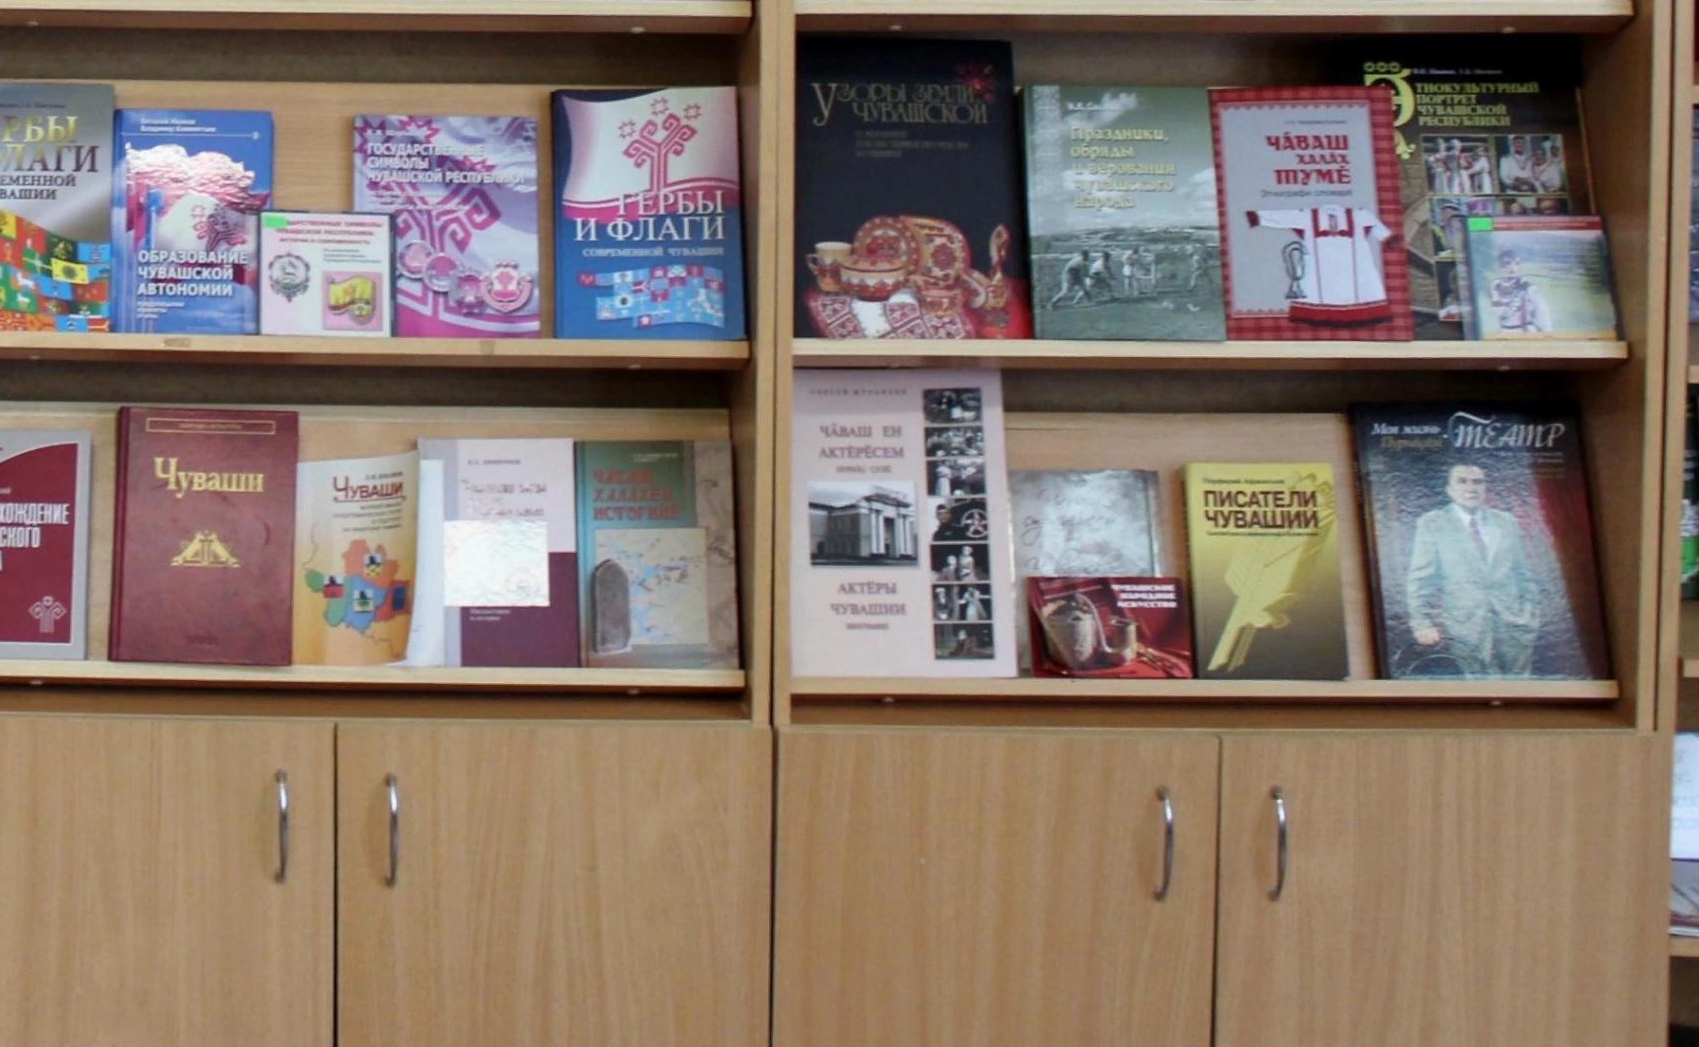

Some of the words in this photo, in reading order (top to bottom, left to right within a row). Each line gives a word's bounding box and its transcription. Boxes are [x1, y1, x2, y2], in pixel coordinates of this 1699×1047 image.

[810, 82, 907, 127] УЗОРЫ
[912, 83, 974, 102] ЗЕМЛИ
[1415, 94, 1477, 105] ПОРТРЕТ
[851, 102, 988, 124] ЧУВАШСКОЙ
[1416, 104, 1507, 117] ЧУВАШСКОЙ
[1417, 115, 1512, 128] РЕСПУБЛИКИ
[1069, 126, 1169, 143] Праздники,
[367, 143, 485, 157] ГОСУДАРСТВЕННЫЕ
[1069, 142, 1135, 159] обряды
[367, 157, 430, 170] СИМВОЛЫ
[367, 169, 443, 184] ЧУВАШСКОЙ
[617, 190, 727, 216] ГЕРБЫ
[1073, 195, 1135, 210] народа
[573, 217, 599, 242] И
[606, 217, 726, 242] ФЛАГИ
[137, 249, 248, 264] ОБРАЗОВАНИЕ
[137, 265, 234, 281] ЧУВАШСКОЙ
[137, 281, 234, 298] АВТОНОМИИ
[882, 424, 902, 438] ЕН
[154, 457, 265, 500] Чуваши
[333, 476, 404, 501] ЧУВАШИ
[1203, 490, 1316, 508] ПИСАТЕЛИ
[1204, 509, 1319, 529] ЧУВАШИИ
[829, 601, 907, 616] ЧУВАШИИ
